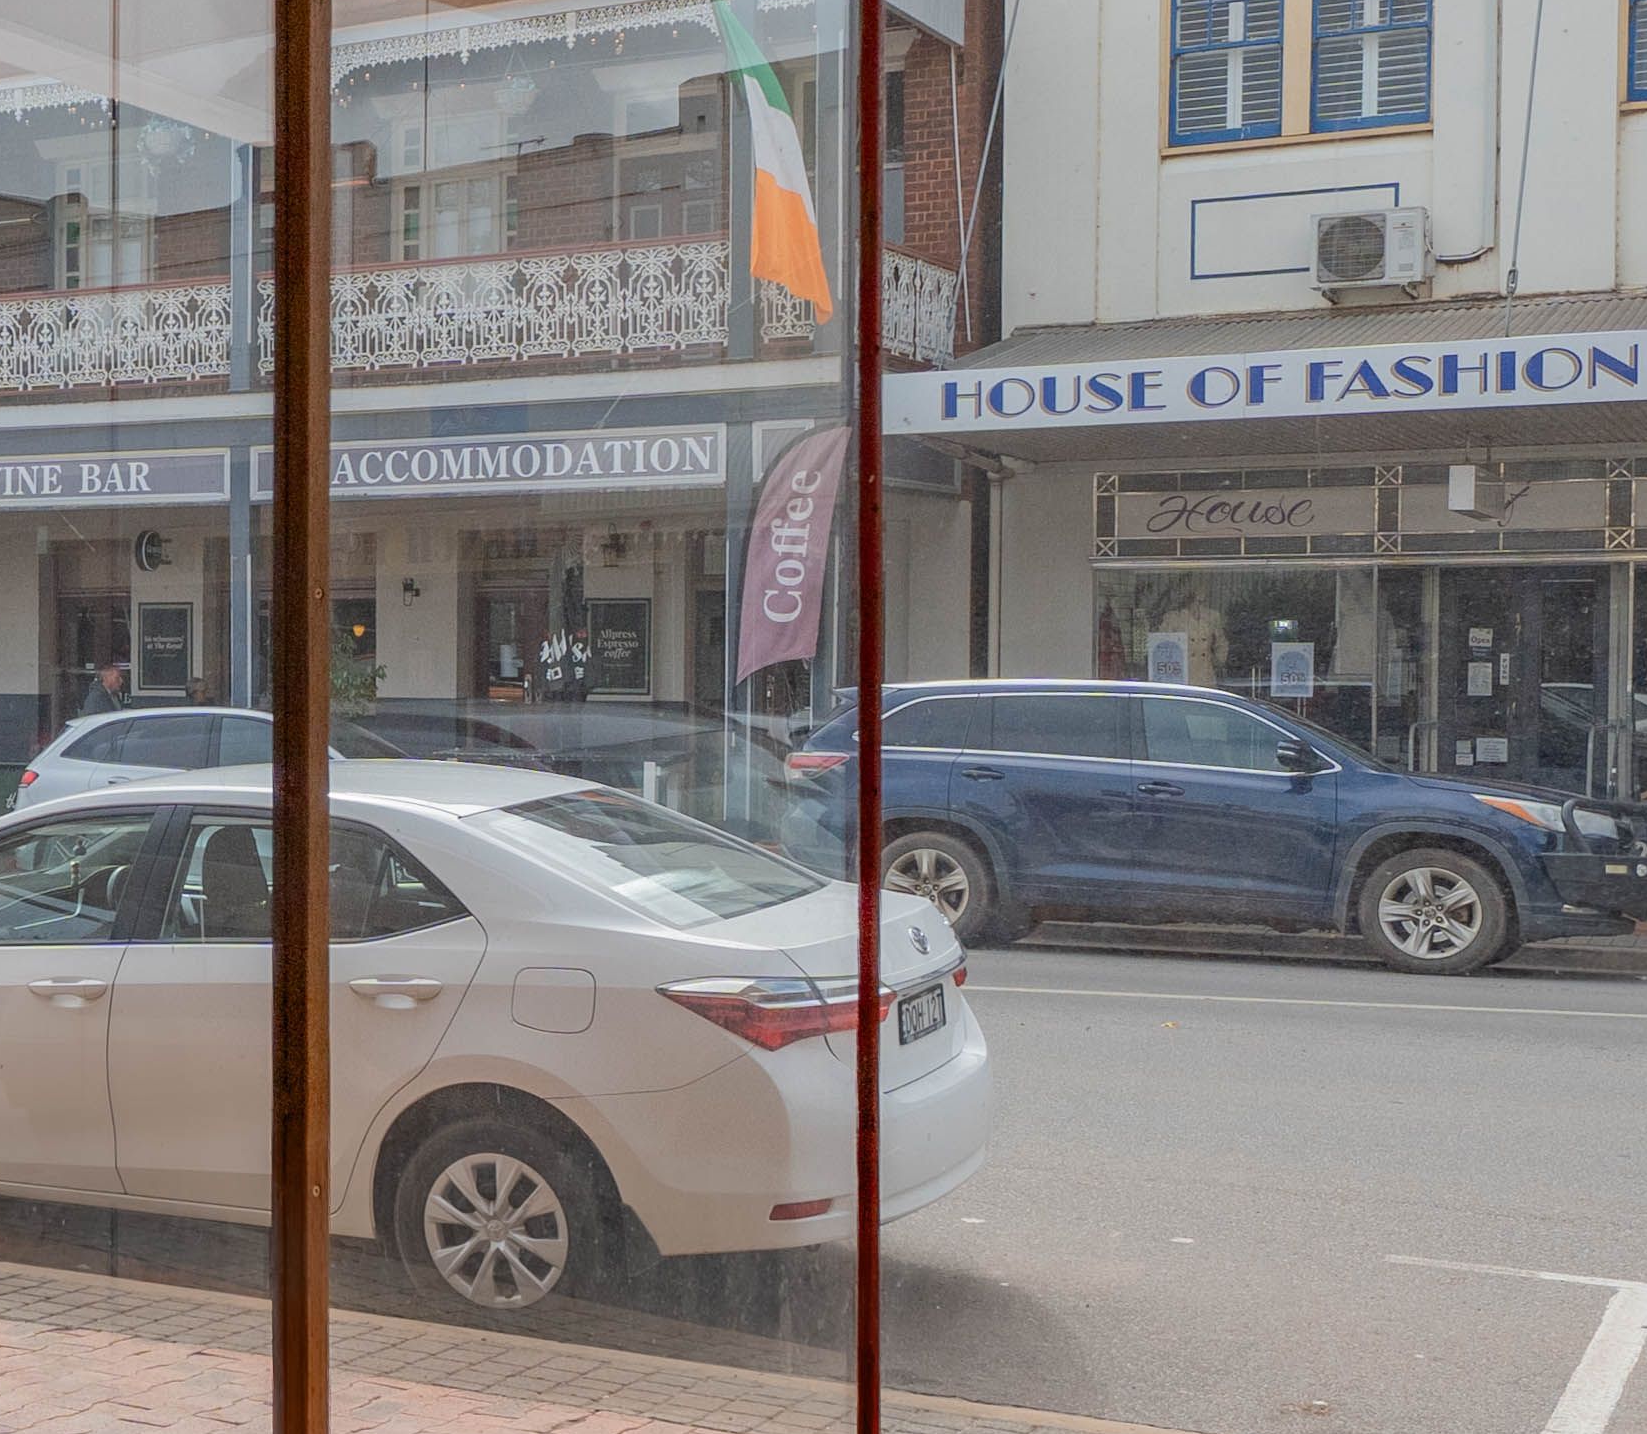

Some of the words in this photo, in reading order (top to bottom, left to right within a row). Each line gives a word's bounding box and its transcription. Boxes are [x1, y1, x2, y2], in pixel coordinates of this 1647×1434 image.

[941, 371, 1167, 421] HOUSE
[1186, 364, 1283, 408] OF
[1304, 343, 1639, 404] FASHION
[79, 461, 152, 494] BAR
[331, 435, 714, 484] ACCOMMODATION
[1146, 494, 1315, 532] House
[763, 469, 822, 623] Coffee
